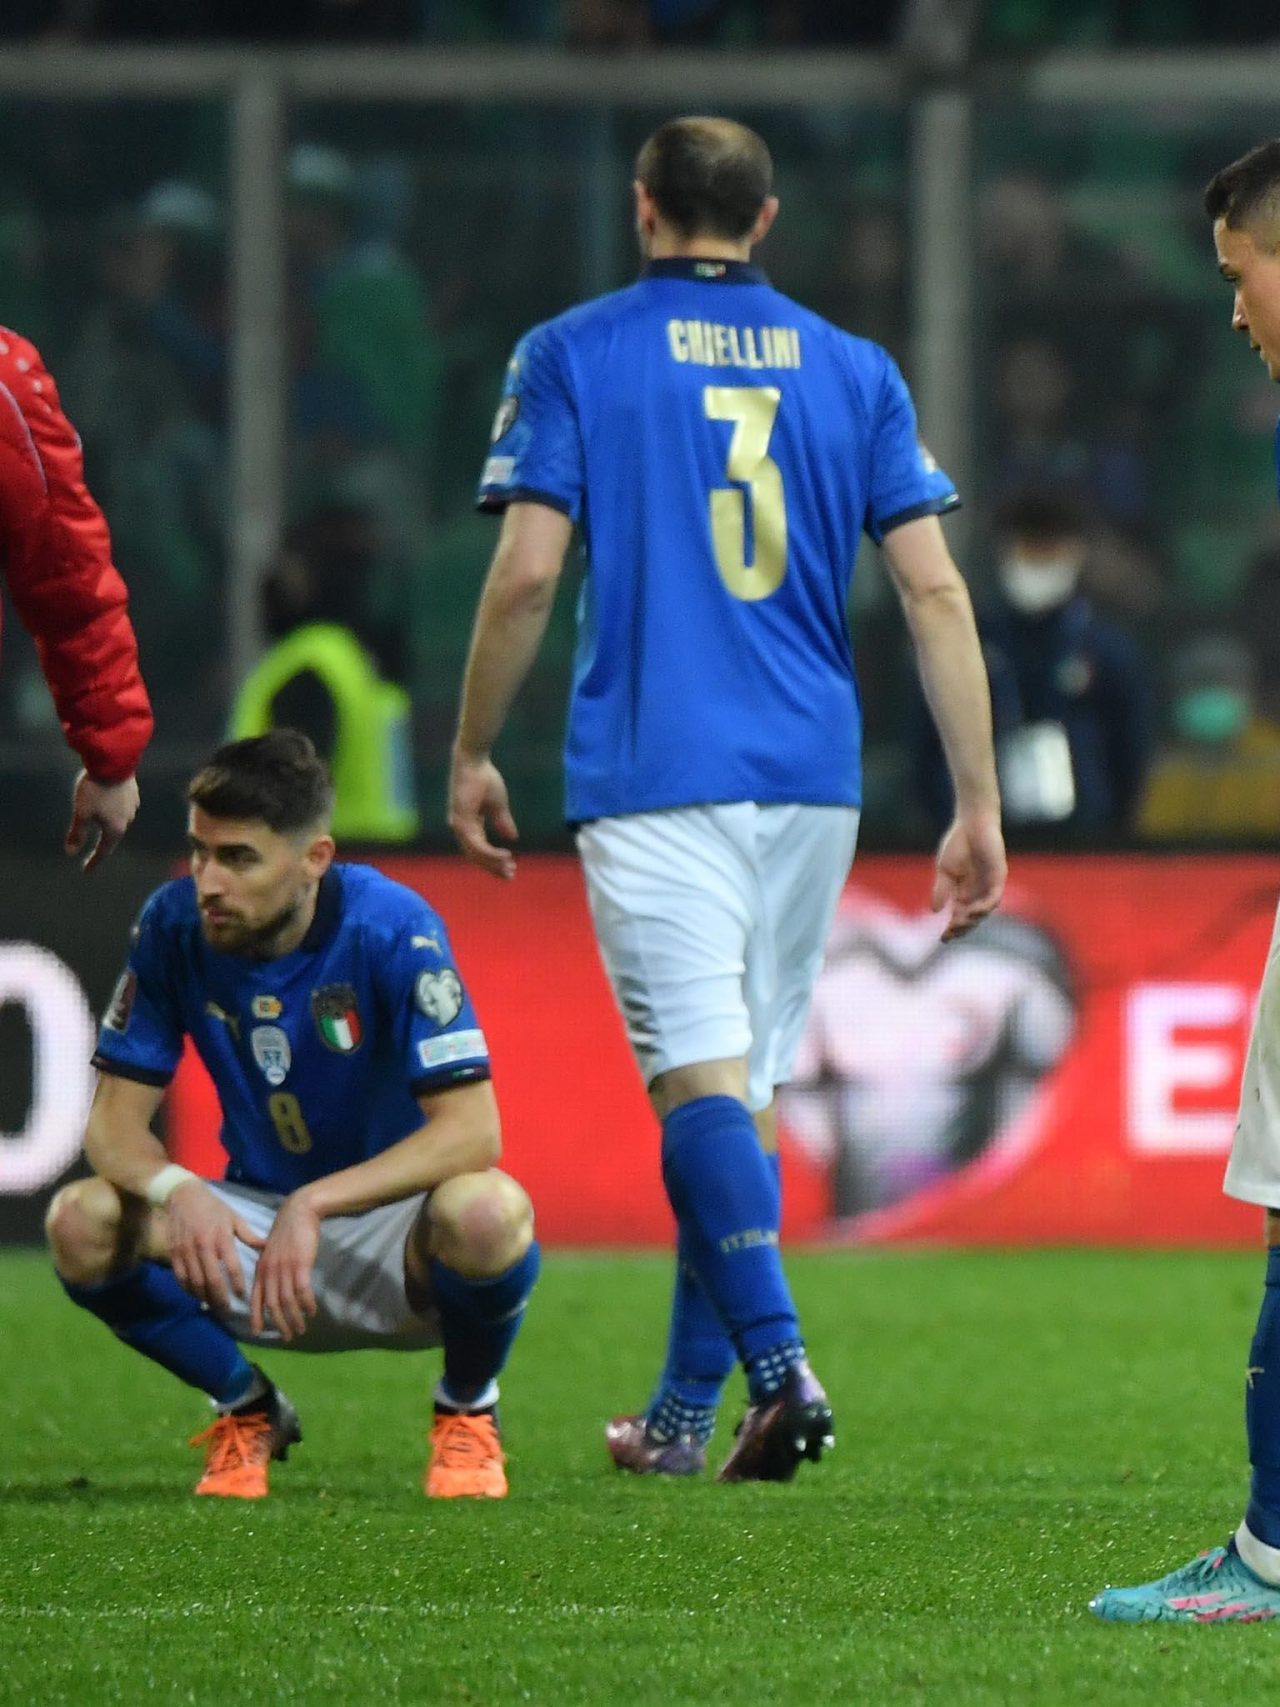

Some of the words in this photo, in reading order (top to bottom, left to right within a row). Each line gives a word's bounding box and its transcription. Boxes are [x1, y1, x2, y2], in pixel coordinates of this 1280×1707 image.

[667, 319, 801, 369] CHIELLINI
[704, 386, 788, 601] 3
[268, 1091, 313, 1154] 8
